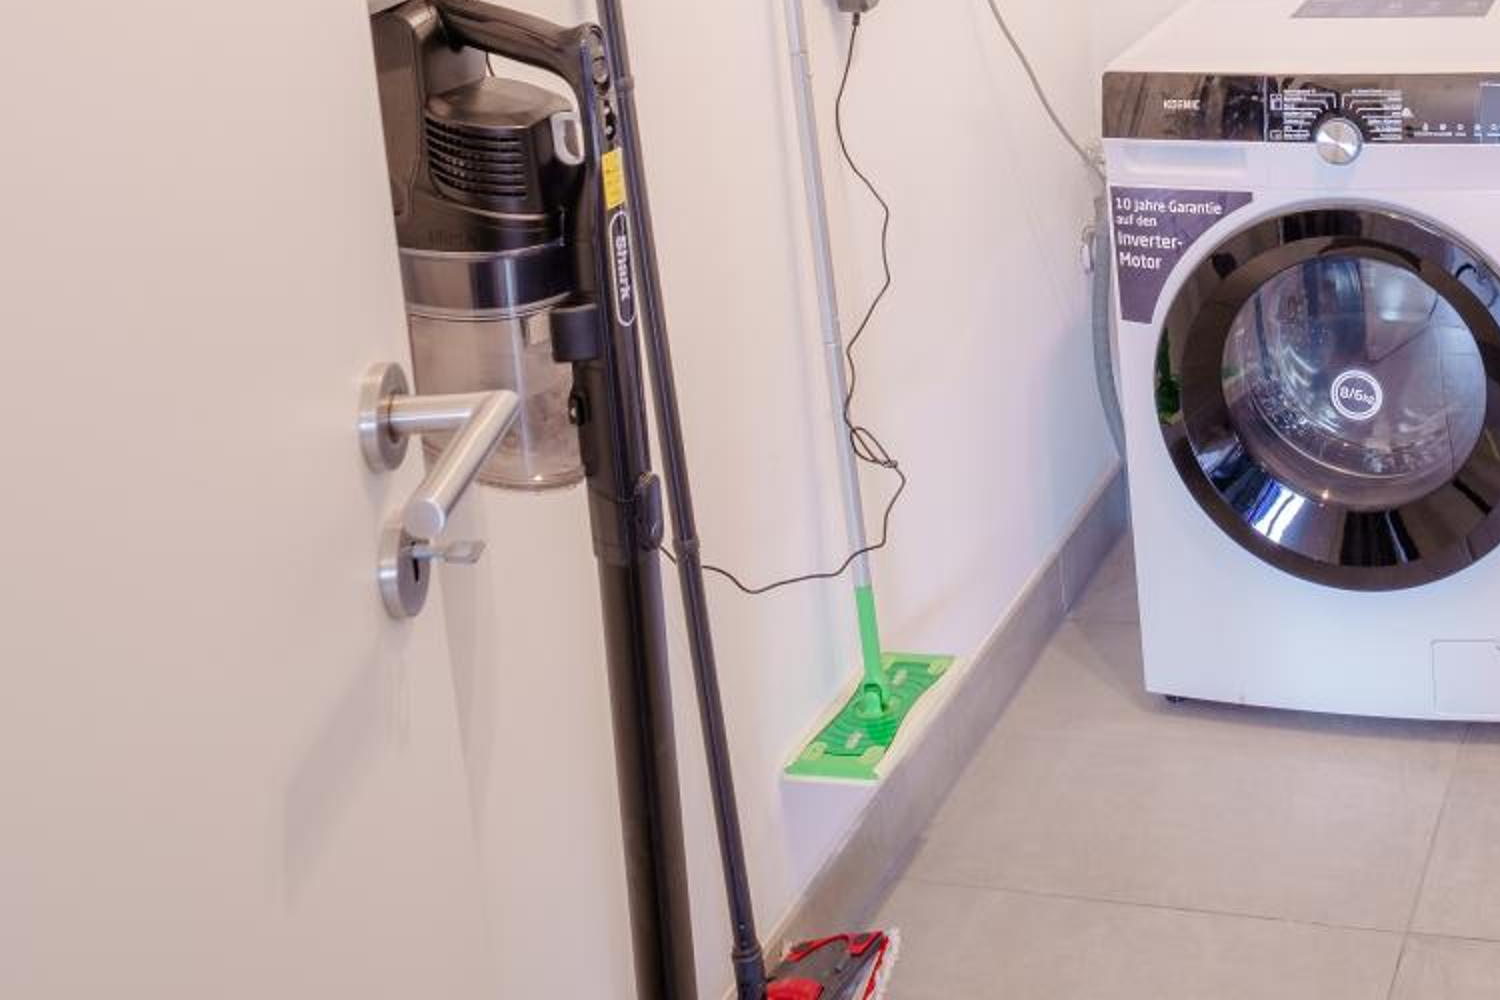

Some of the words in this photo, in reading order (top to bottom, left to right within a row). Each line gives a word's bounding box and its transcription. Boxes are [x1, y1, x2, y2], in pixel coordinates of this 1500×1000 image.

[1115, 197, 1131, 211] 10
[1134, 199, 1166, 213] Jahre
[1168, 200, 1223, 215] Garantie
[1116, 213, 1134, 226] auf
[1135, 215, 1157, 227] den
[1117, 231, 1183, 249] Inverter-
[615, 234, 631, 301] Shark
[1119, 251, 1162, 269] Motor
